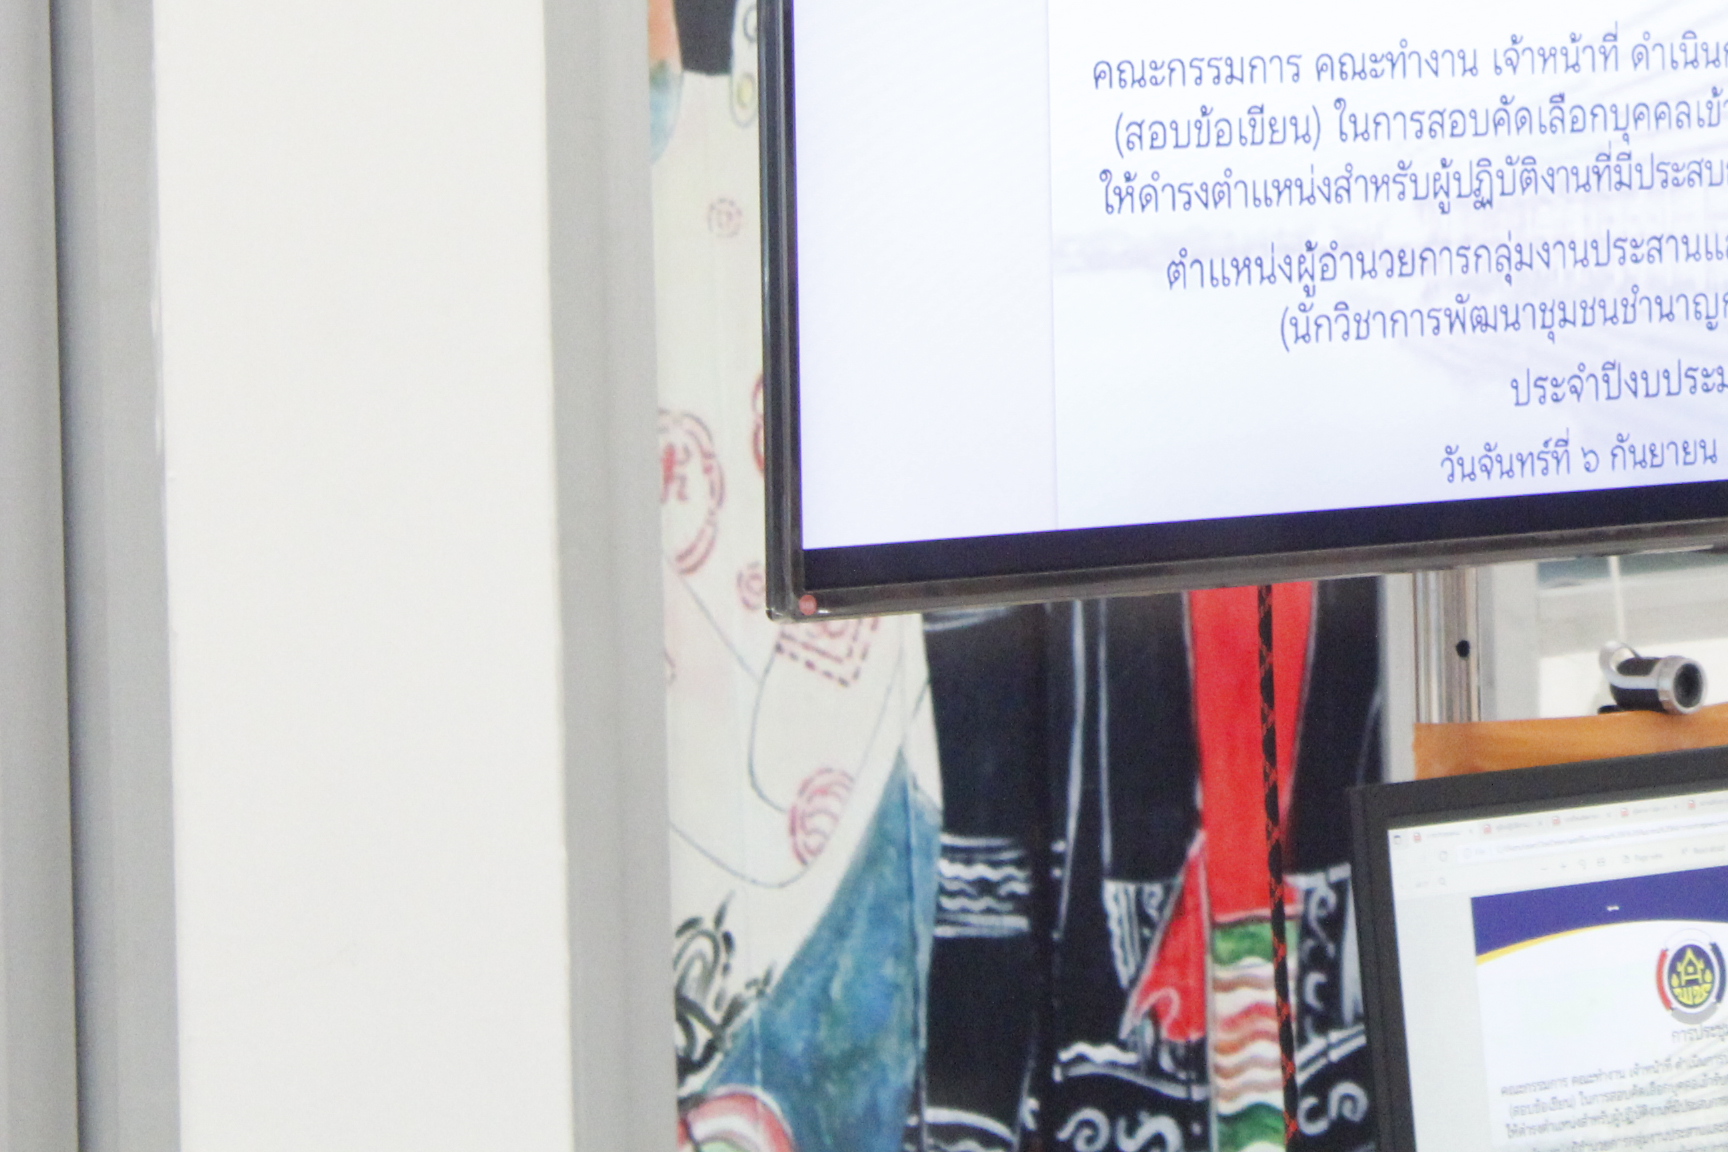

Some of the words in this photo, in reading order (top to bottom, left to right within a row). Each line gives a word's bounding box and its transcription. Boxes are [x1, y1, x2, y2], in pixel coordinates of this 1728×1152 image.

[1093, 52, 1302, 90] คณะกรรมการ
[1315, 39, 1479, 82] คณะทำงาน
[1492, 21, 1620, 77] เจ้าหน้าที่
[1115, 103, 1321, 158] (สอบข้อเขียน)
[1441, 428, 1571, 484] วันจันทร์ที่
[1581, 447, 1600, 473] ๖
[1610, 433, 1718, 471] กันยายน
